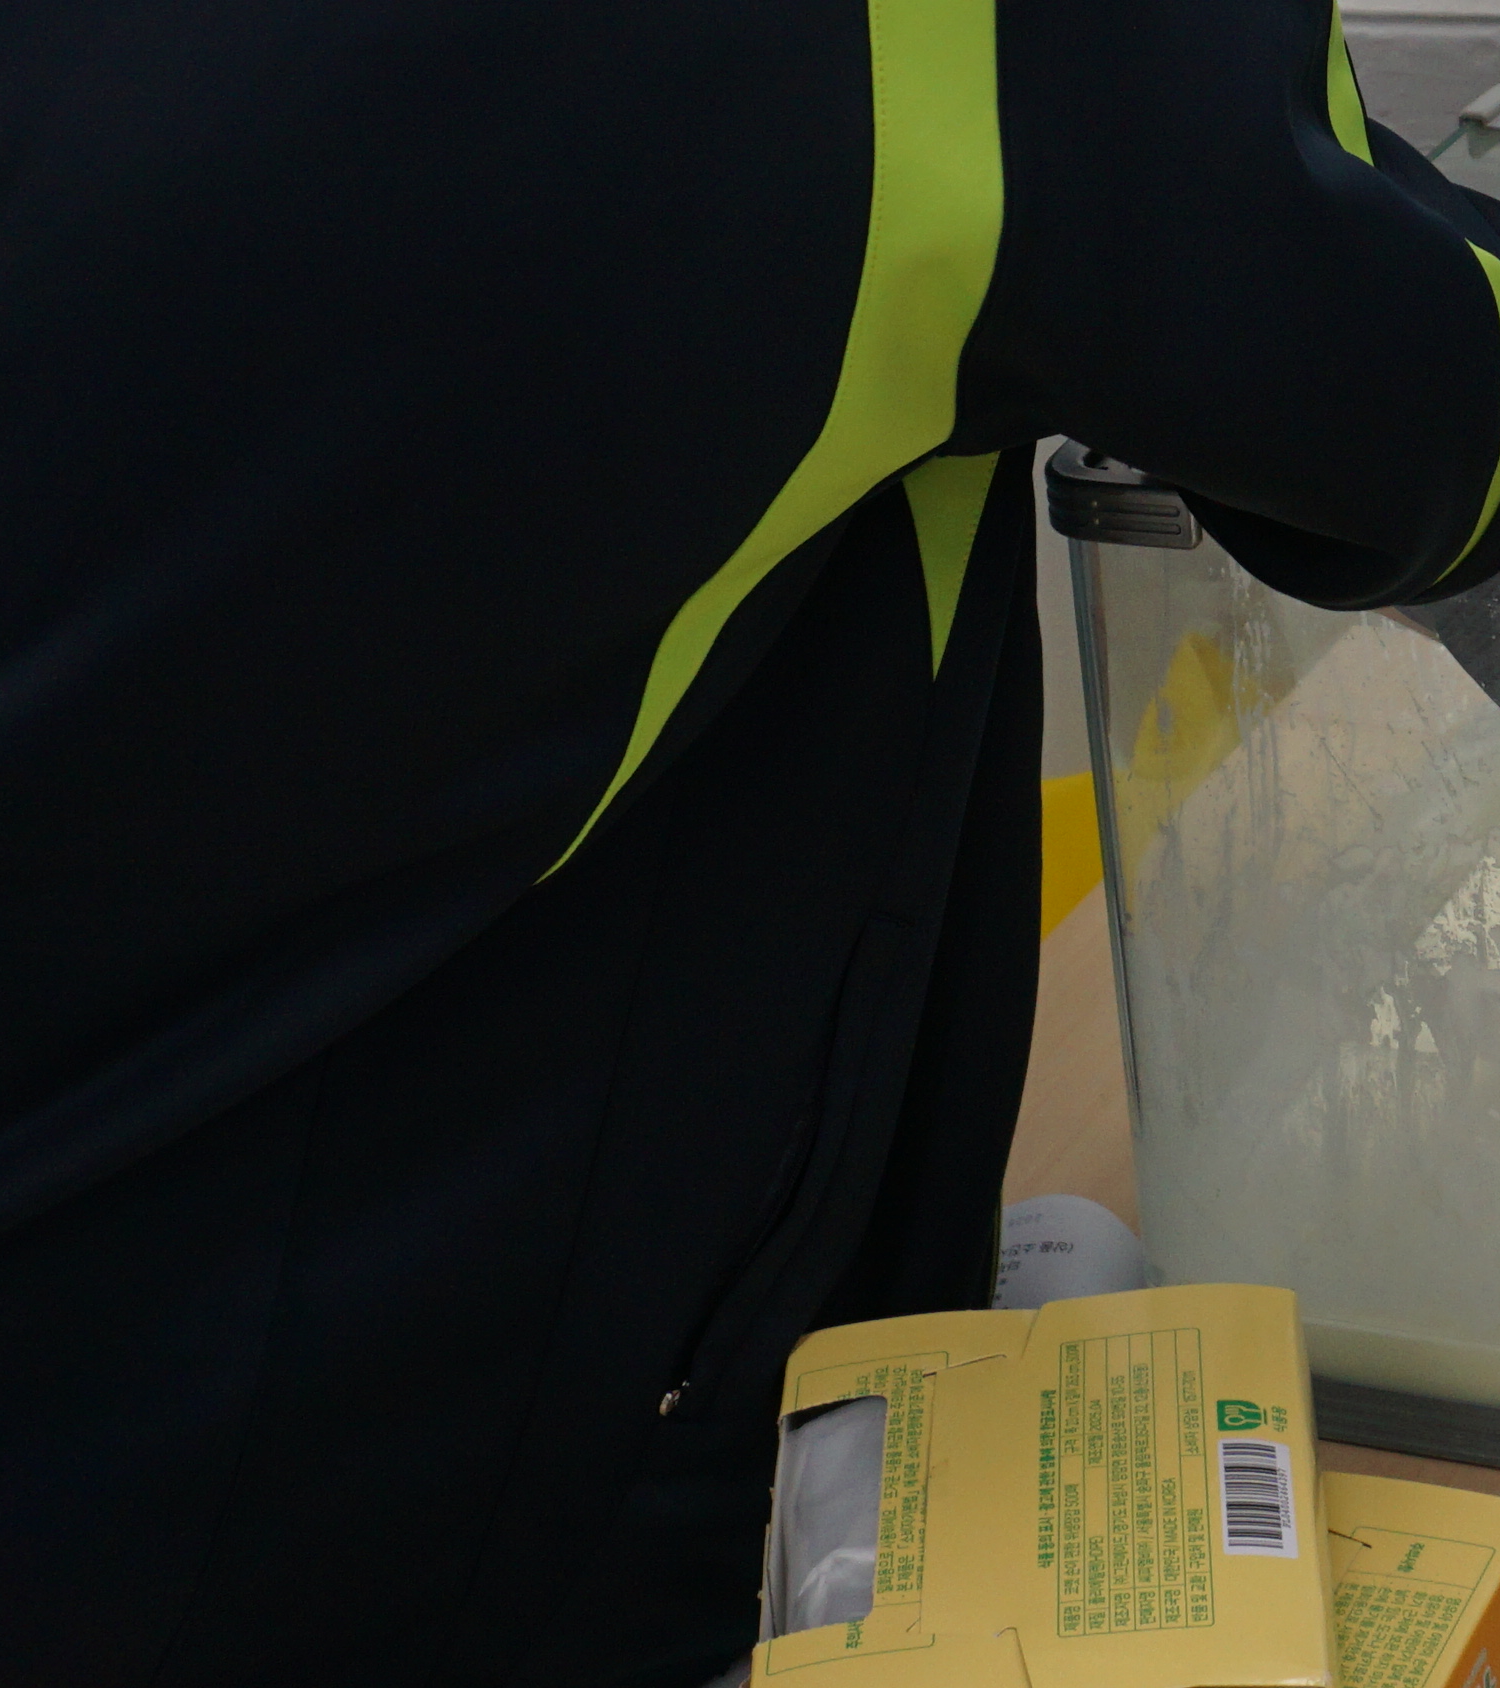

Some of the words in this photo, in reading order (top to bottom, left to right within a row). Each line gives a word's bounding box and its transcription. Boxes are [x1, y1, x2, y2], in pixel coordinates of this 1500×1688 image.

[1184, 1431, 1199, 1454] 소비자
[1135, 1471, 1152, 1493] 송파구
[1162, 1478, 1176, 1506] KOREA
[1064, 1484, 1079, 1507] 500매
[1064, 1509, 1080, 1540] 위생장갑
[1136, 1496, 1152, 1535] 서울특별시
[1162, 1517, 1178, 1543] MADE
[1187, 1534, 1204, 1542] 및
[1188, 1544, 1205, 1569] 구입처
[1397, 1542, 1425, 1573] 주의사항
[1189, 1575, 1207, 1592] 교환
[1113, 1593, 1131, 1626] 제조자명
[1164, 1589, 1181, 1623] 제조국명
[1191, 1594, 1207, 1603] 및
[1064, 1606, 1080, 1631] 제품명
[1088, 1611, 1105, 1630] 재질
[1192, 1604, 1208, 1621] 반품
[845, 1618, 865, 1649] 주의사
